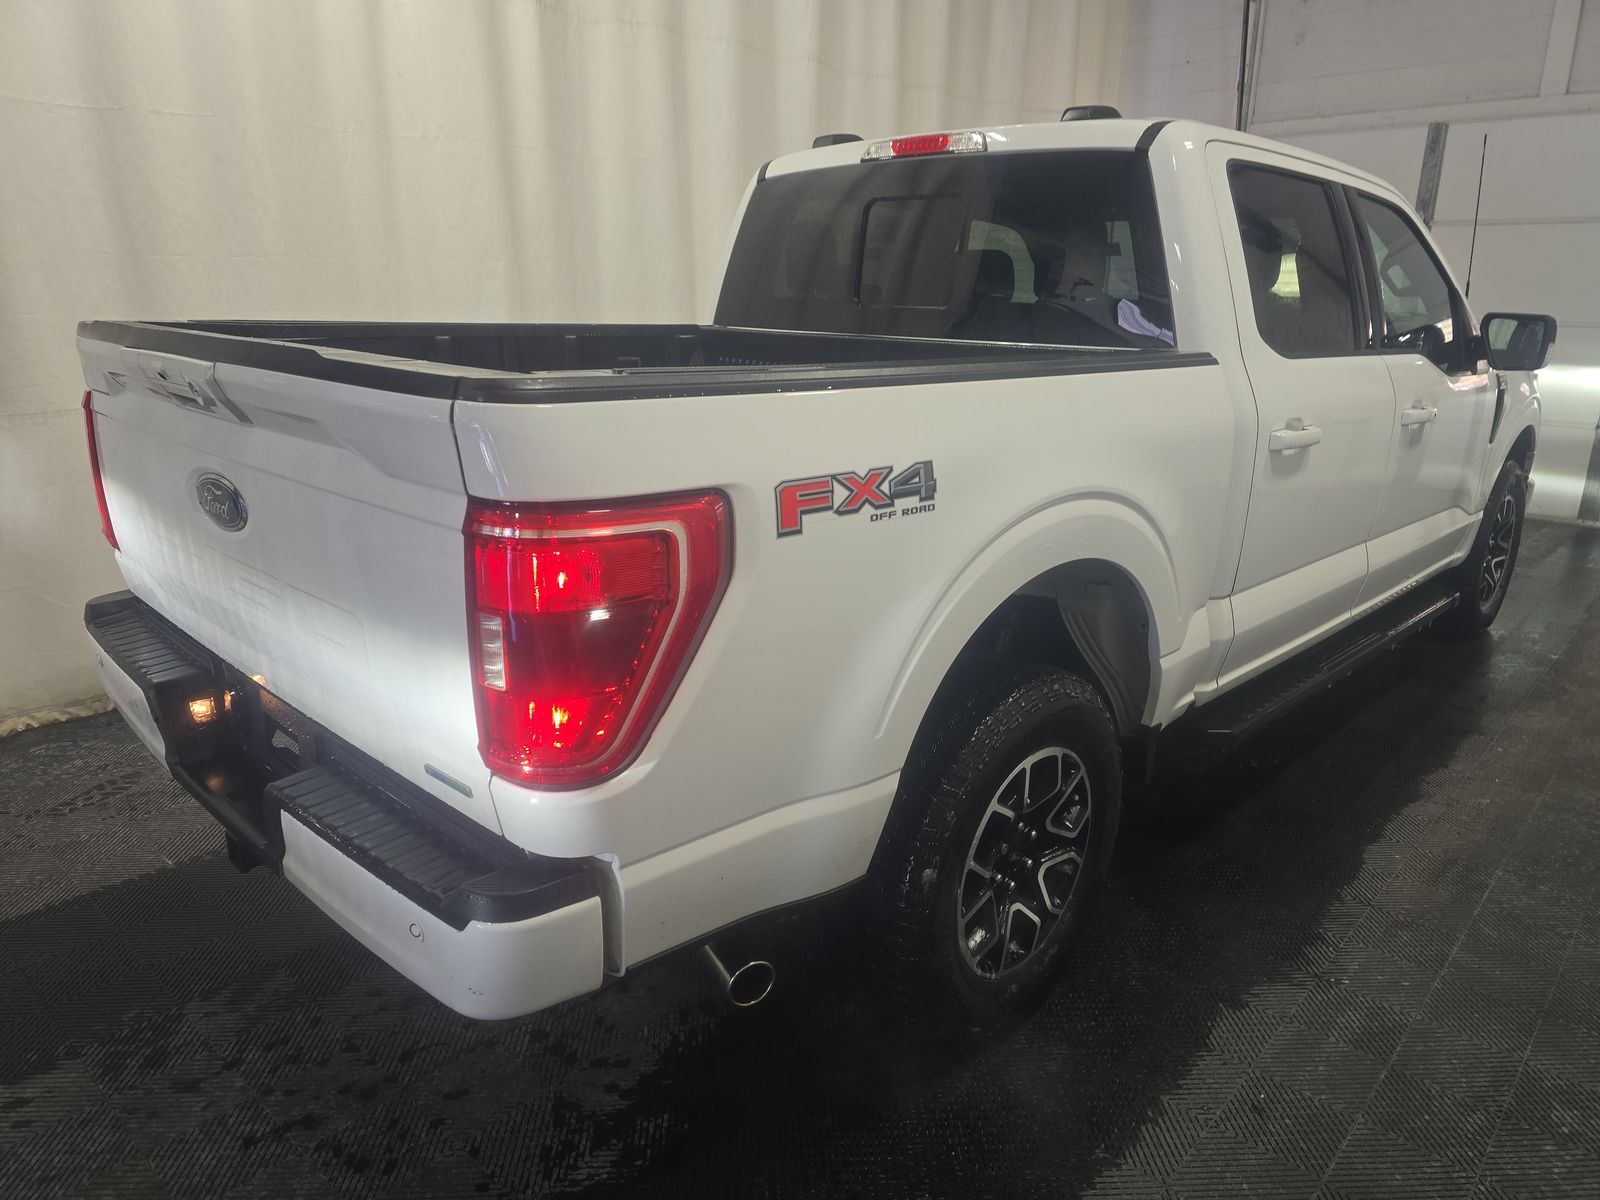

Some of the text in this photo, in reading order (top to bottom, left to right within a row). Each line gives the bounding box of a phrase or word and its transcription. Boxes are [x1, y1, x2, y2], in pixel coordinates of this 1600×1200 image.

[204, 484, 229, 520] Ford
[774, 459, 937, 539] FX4
[870, 503, 935, 522] OFF ROAD
